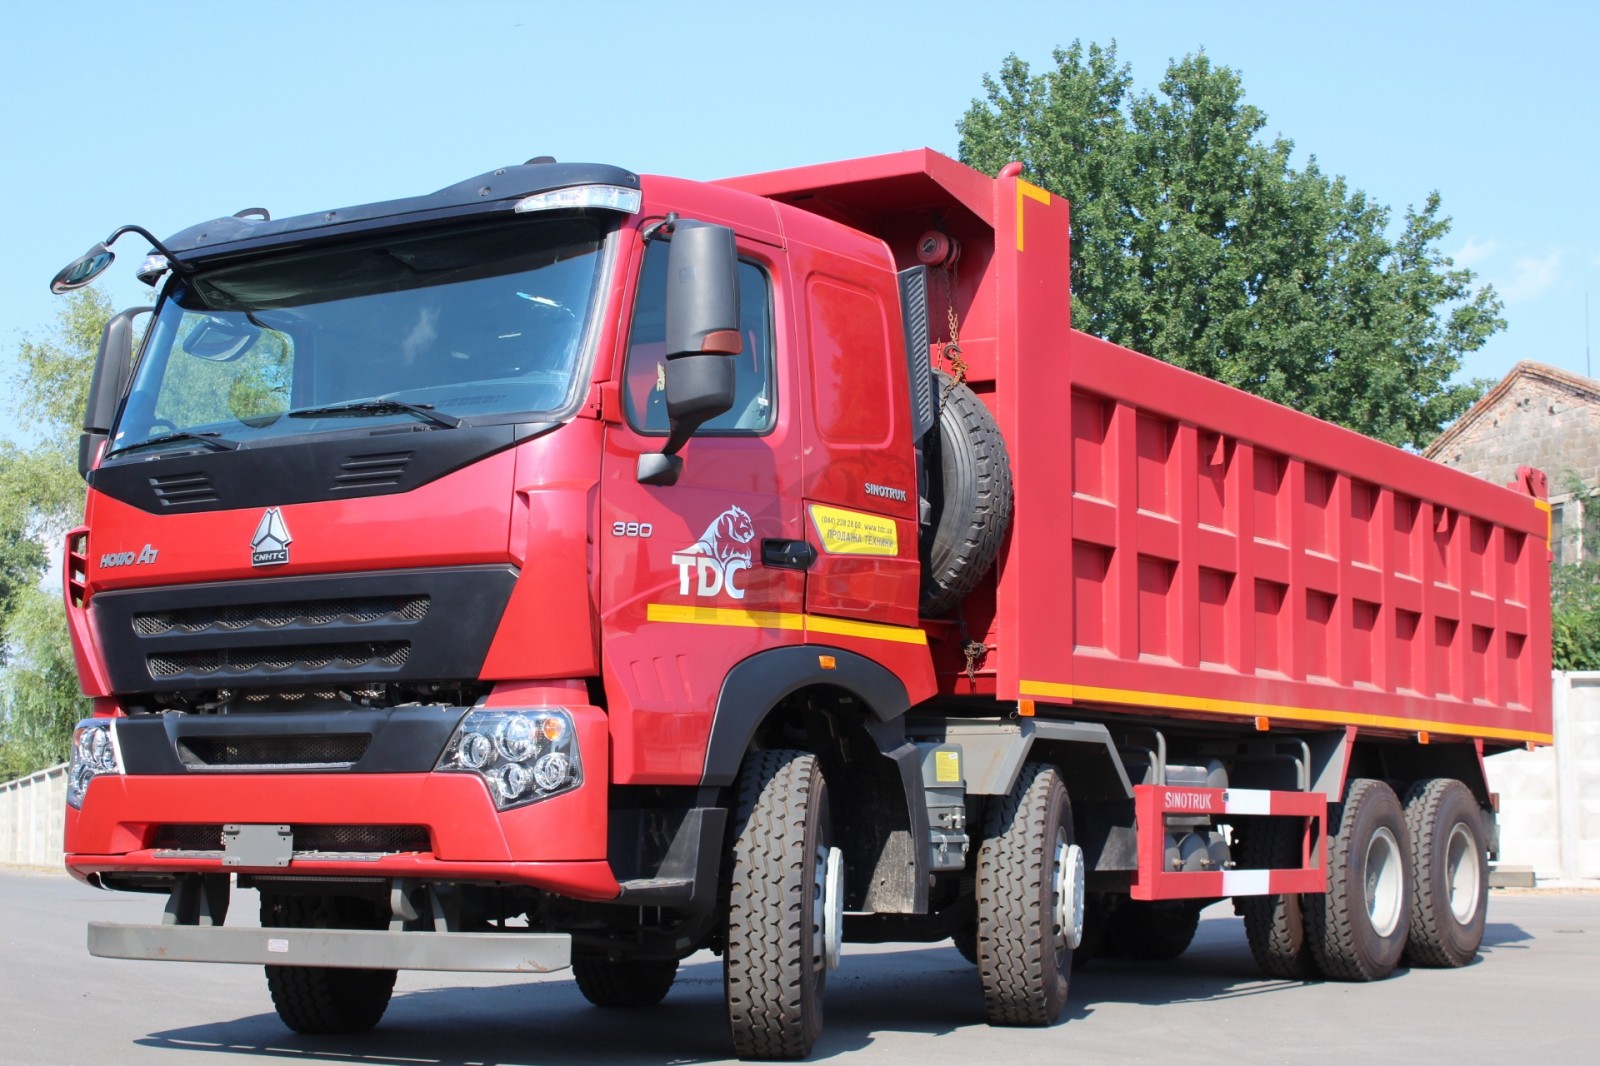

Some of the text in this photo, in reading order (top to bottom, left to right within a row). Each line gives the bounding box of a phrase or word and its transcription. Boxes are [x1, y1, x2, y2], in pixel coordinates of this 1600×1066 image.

[864, 482, 907, 502] SINOTRUK
[821, 515, 835, 525] (044)
[612, 521, 653, 538] 380
[827, 529, 862, 543] ПРОДАЖА
[99, 543, 159, 569] HOWO A7
[253, 551, 286, 562] CNHTC
[671, 554, 747, 599] TDC
[1165, 792, 1212, 809] SINOTRUK
